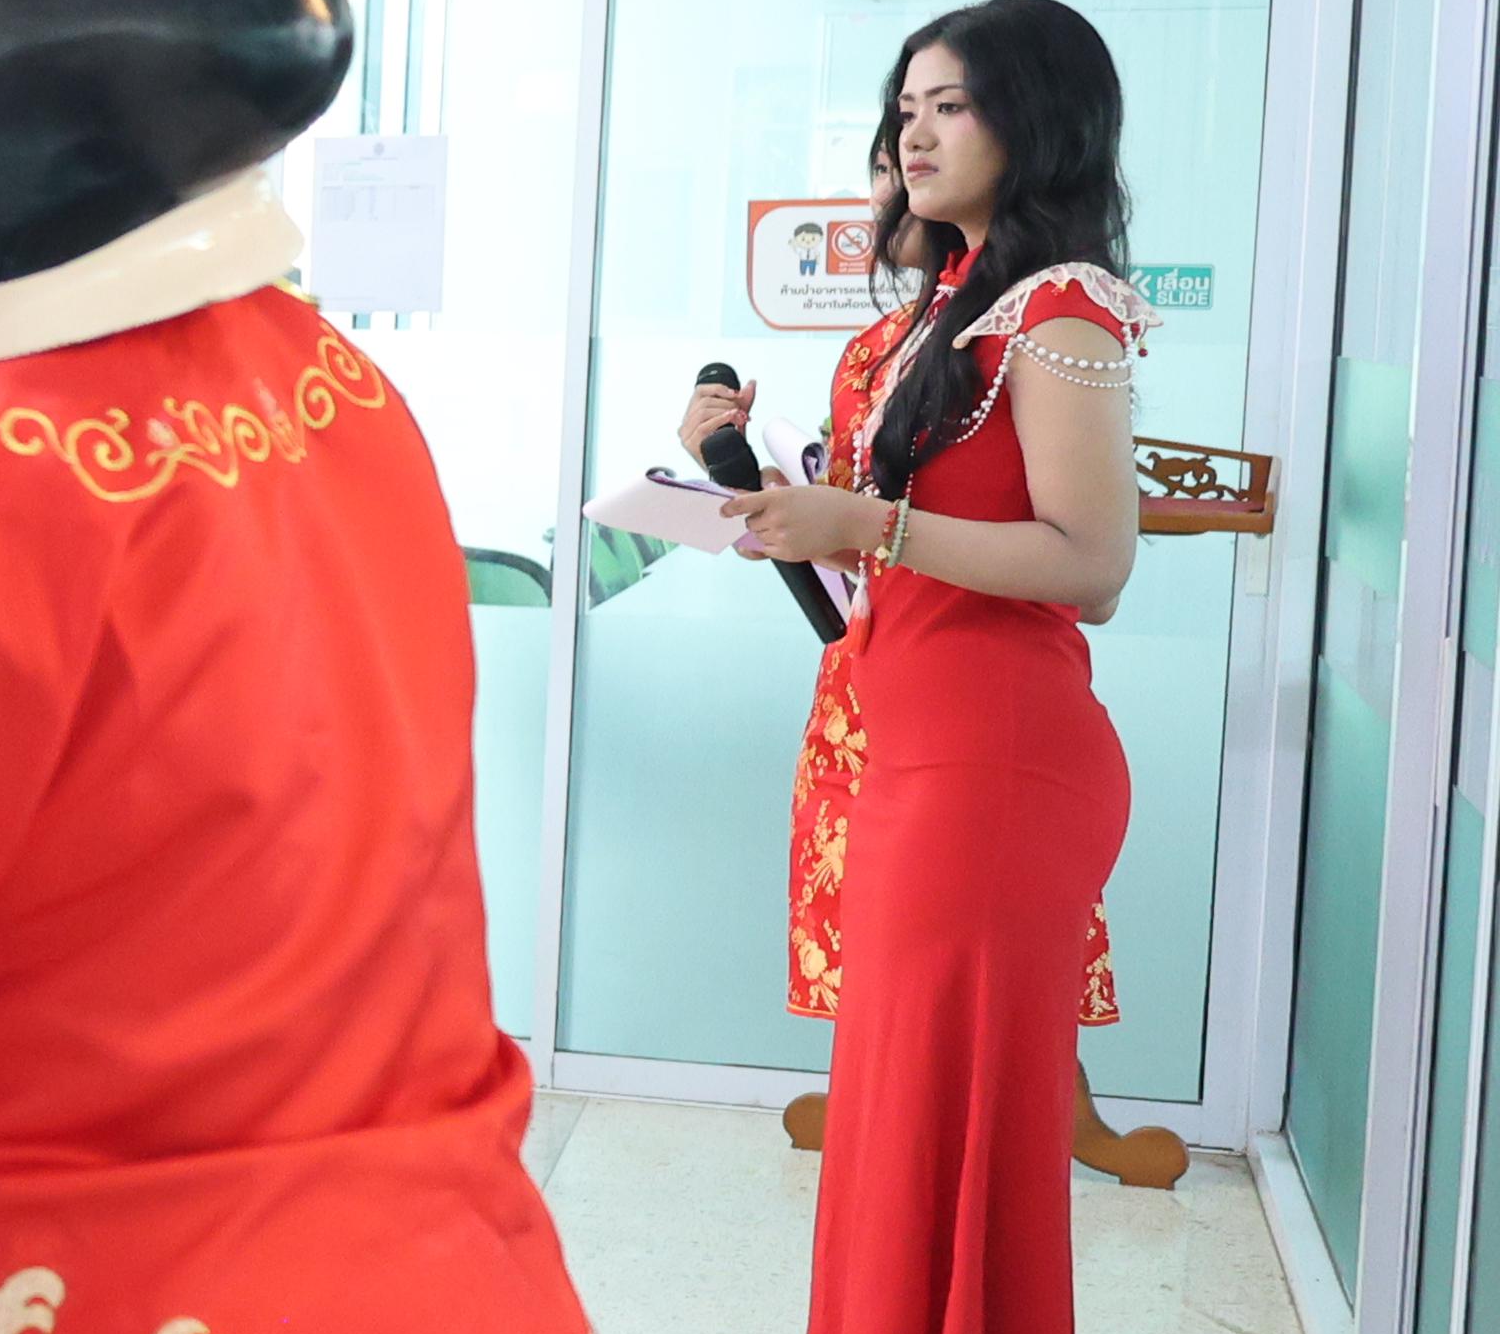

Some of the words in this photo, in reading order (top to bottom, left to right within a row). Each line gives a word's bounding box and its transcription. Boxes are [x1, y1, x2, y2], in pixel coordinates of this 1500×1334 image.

[1156, 268, 1209, 291] เลื่อน
[1156, 290, 1208, 305] SLIDE
